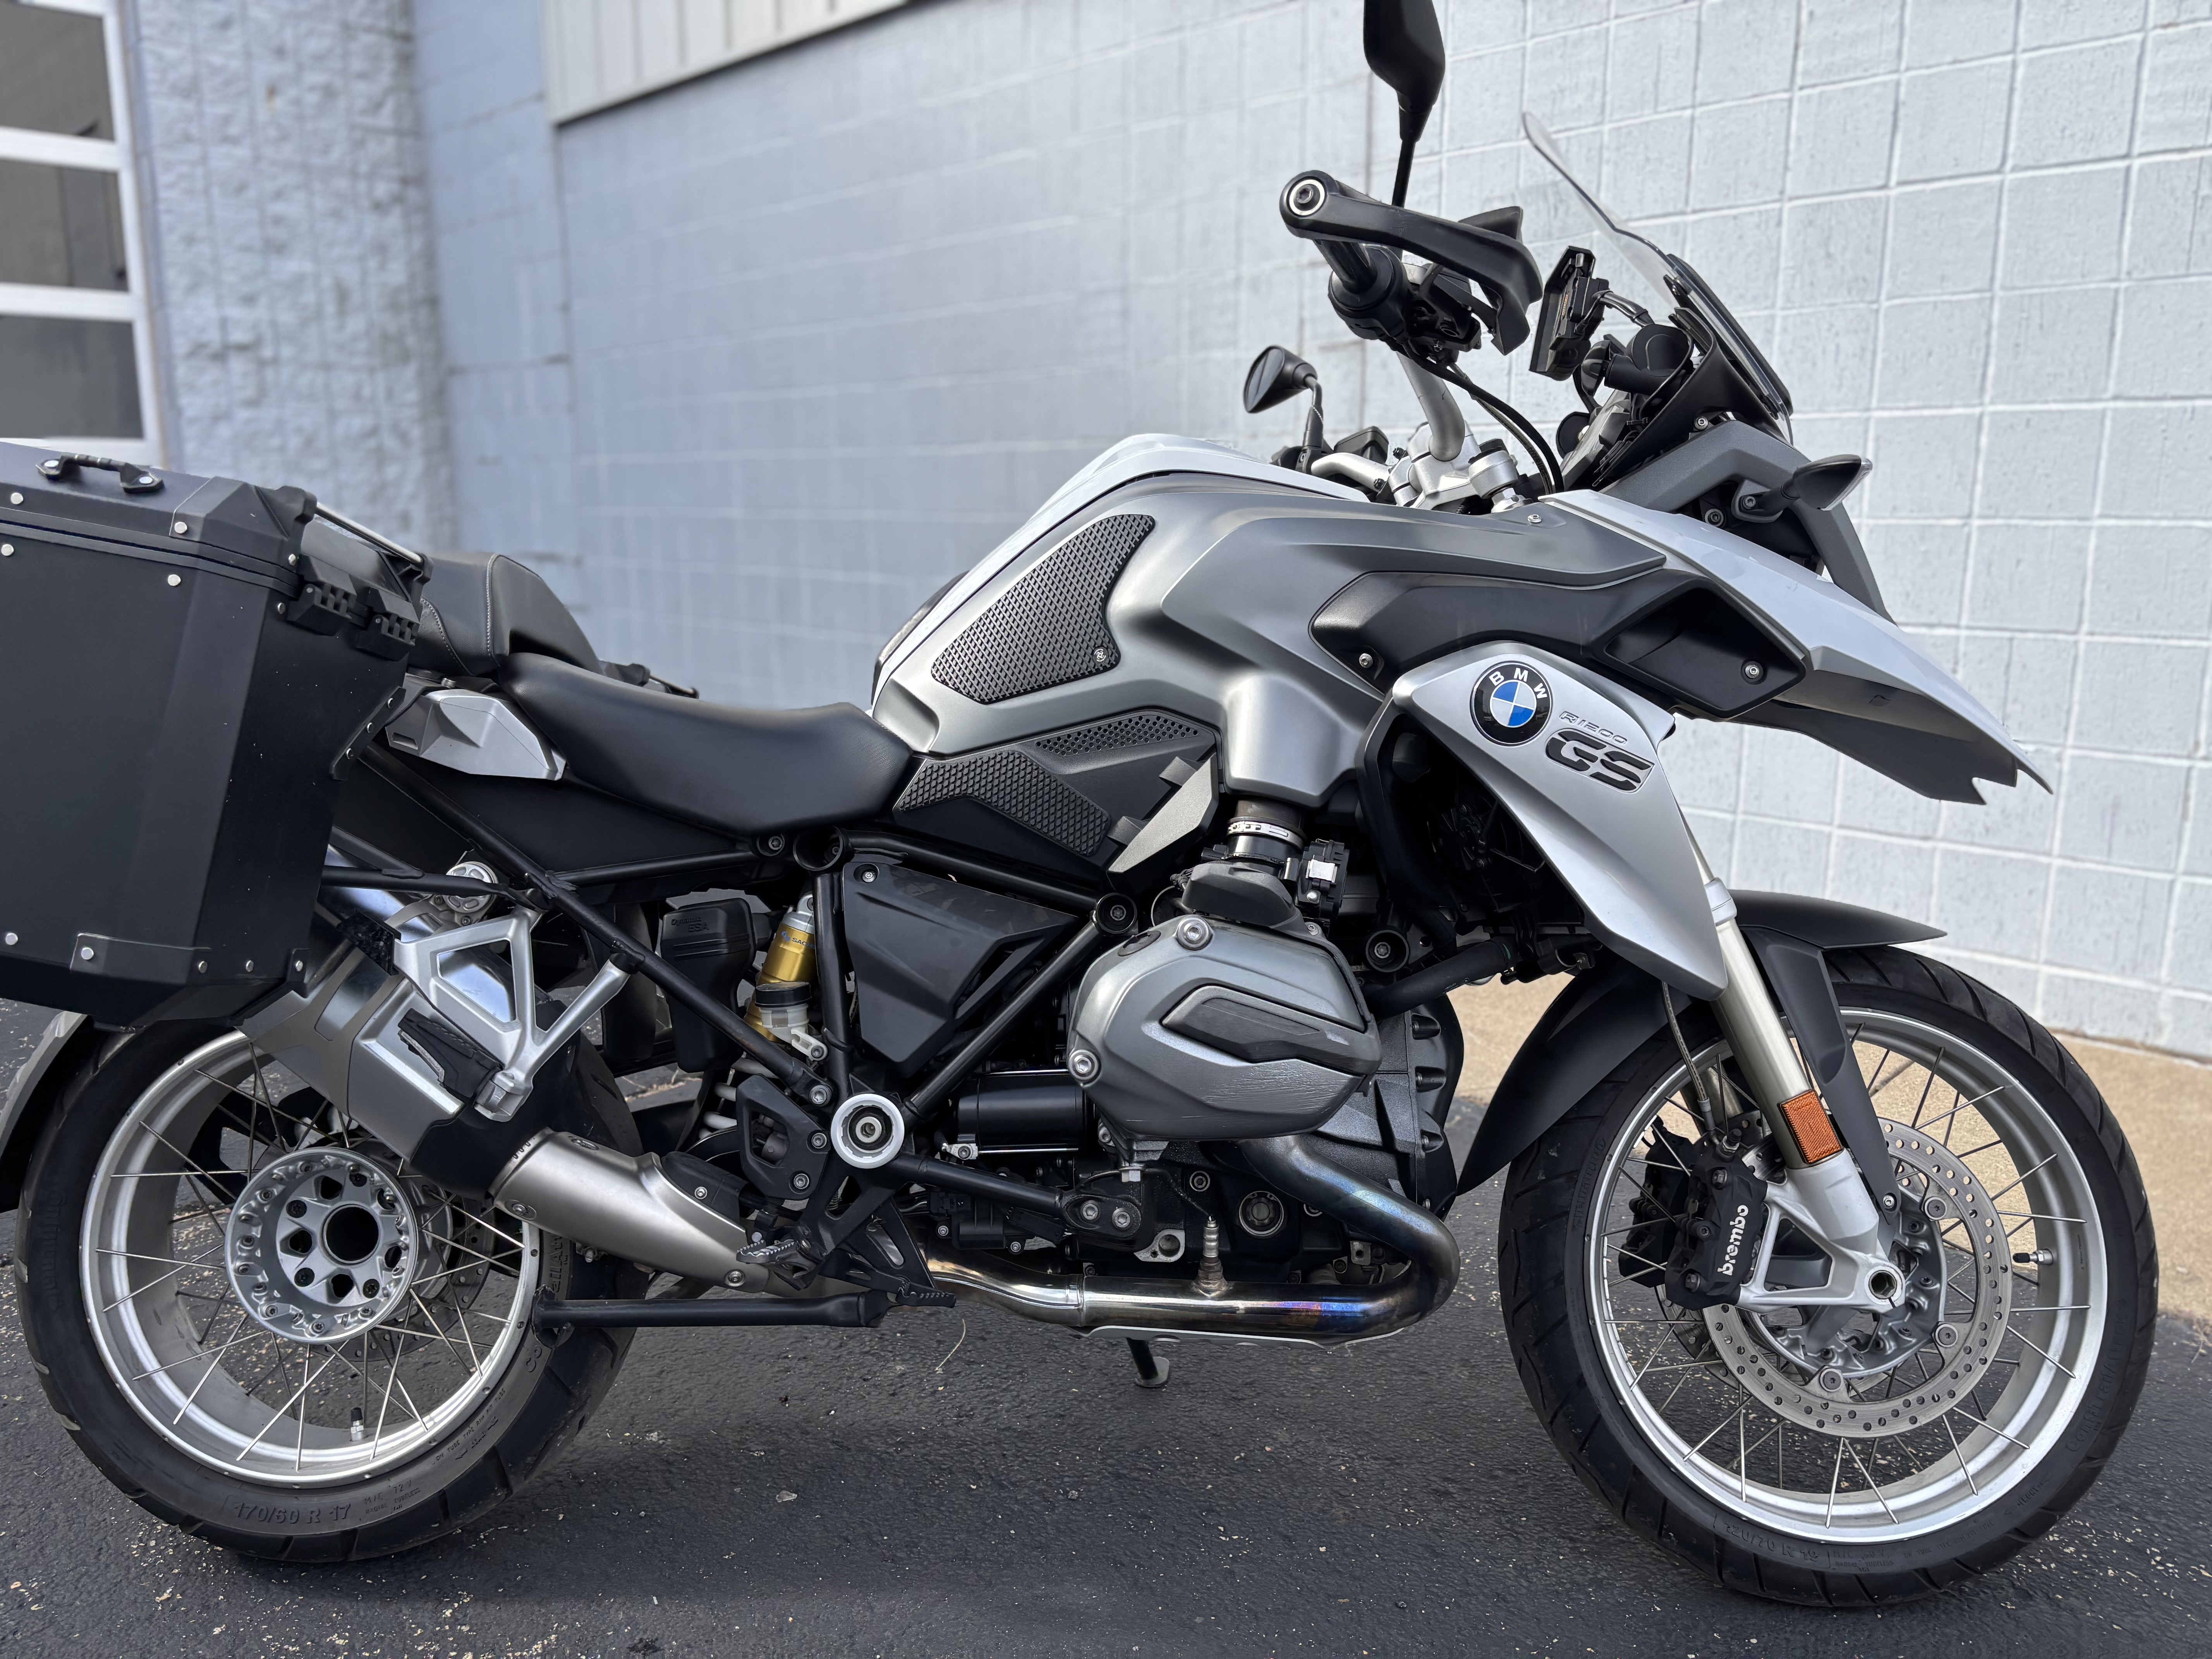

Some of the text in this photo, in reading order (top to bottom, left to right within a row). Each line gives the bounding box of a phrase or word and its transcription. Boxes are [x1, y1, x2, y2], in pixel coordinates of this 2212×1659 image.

[1489, 668, 1547, 699] BMW
[1546, 730, 1655, 792] GS
[688, 922, 709, 933] ESA
[1717, 1204, 1749, 1276] brembo
[307, 1508, 321, 1524] R
[329, 1503, 351, 1521] 17
